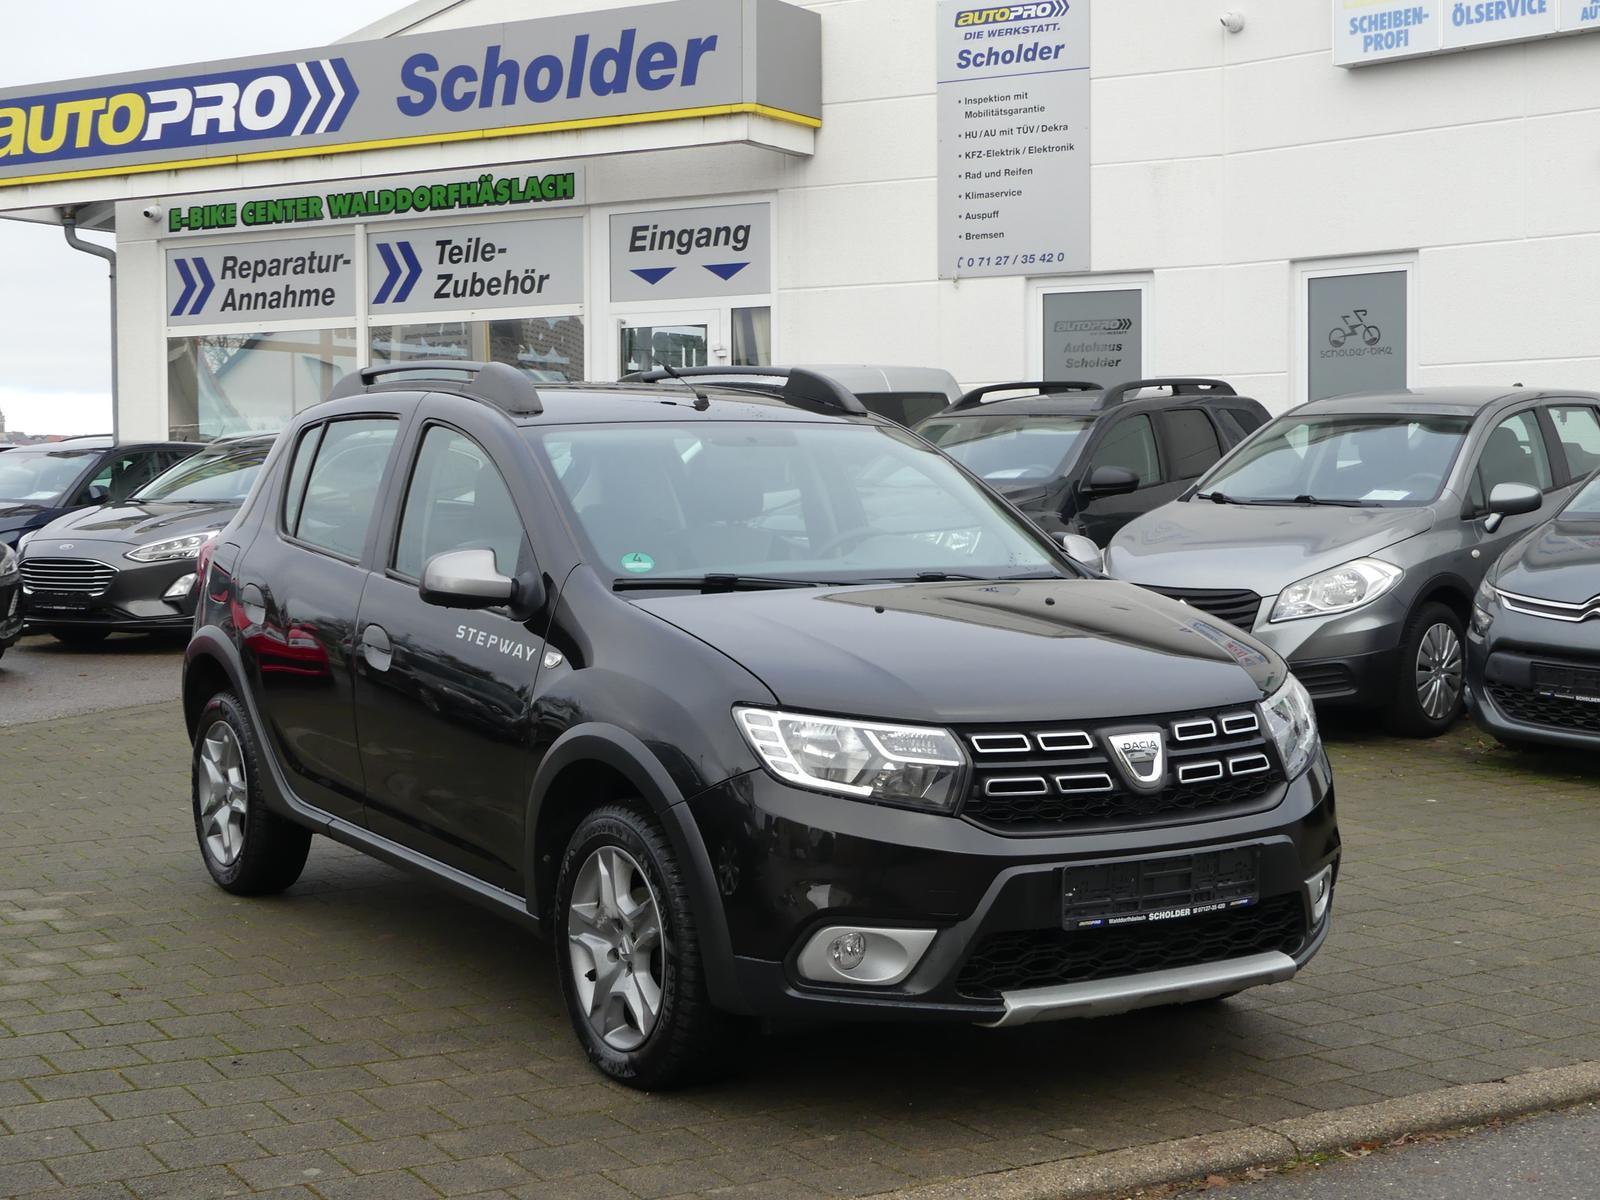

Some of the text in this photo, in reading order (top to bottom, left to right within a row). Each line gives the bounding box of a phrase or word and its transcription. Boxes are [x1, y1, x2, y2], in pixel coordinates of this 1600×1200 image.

[1349, 6, 1429, 35] SCHEIBEN-
[1452, 0, 1547, 27] ÖLSERVICE
[1581, 5, 1600, 21] AU
[964, 23, 1060, 40] DIE WERKSTATT.
[1363, 29, 1409, 52] PROFI
[956, 42, 1065, 69] Scholder
[396, 28, 718, 117] Scholder
[964, 92, 1028, 105] Inspektion mit
[964, 105, 1045, 119] Mobilitätsgarantie
[999, 128, 1014, 137] mit
[964, 147, 1021, 160] KFZ-Elektrik
[1028, 143, 1075, 154] Elektronik
[965, 167, 1033, 180] Rad und Reifen
[169, 173, 575, 232] E-BIKE CENTER WALDDORFHÄSLACH
[965, 189, 1023, 200] Klimaservice
[965, 210, 1000, 221] Auspuff
[628, 224, 752, 255] Eingang
[965, 231, 1005, 241] Bremsen
[434, 237, 508, 265] Teile-
[221, 251, 352, 283] Reparatur-
[434, 269, 550, 300] Zubehör
[219, 284, 335, 312] Annahme
[1063, 341, 1123, 353] Autohaus
[1065, 357, 1122, 369] Scholder
[455, 625, 536, 662] STEPWAY
[1122, 740, 1157, 749] DACIA
[1148, 908, 1191, 920] SCHOLDER
